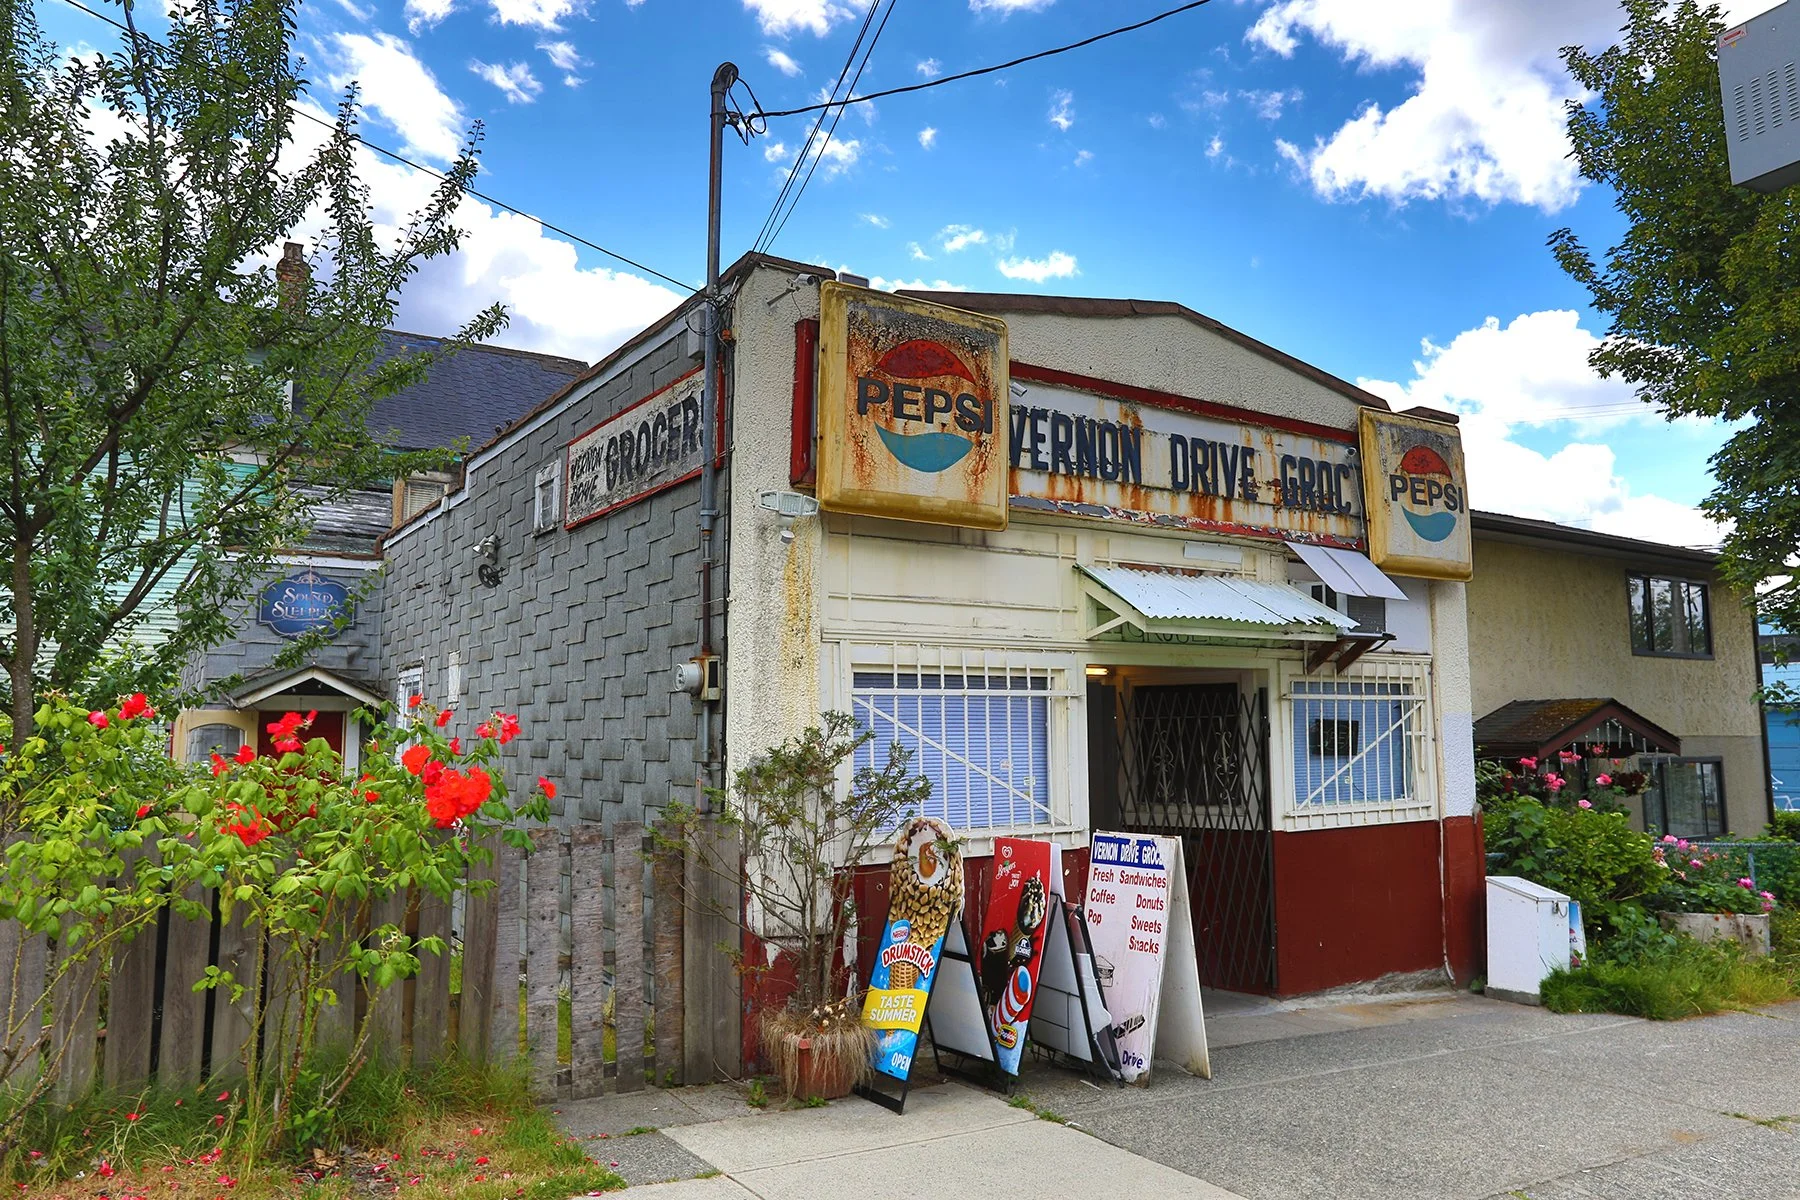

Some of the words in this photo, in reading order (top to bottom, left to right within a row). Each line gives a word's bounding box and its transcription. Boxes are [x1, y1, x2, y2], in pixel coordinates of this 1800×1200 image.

[857, 376, 993, 434] PEPSI
[605, 389, 704, 491] GROCER
[1009, 404, 1142, 484] VERNON
[1170, 432, 1257, 501] DRIVE
[1390, 474, 1465, 514] PEPSI
[1094, 841, 1118, 861] VERNON
[1120, 843, 1139, 864] DRIVE
[1093, 867, 1115, 883] Fresh
[1119, 870, 1167, 889] Sandwiches
[1090, 888, 1116, 905] Coffee
[1136, 893, 1164, 911] Donuts
[1087, 908, 1102, 927] Pop
[1131, 915, 1162, 934] Sweets
[1129, 935, 1159, 954] Snacks
[882, 942, 935, 977] DRUMSTICK
[880, 994, 915, 1008] TASTE
[870, 1008, 917, 1023] SUMMER
[892, 1052, 912, 1072] OPEN
[1122, 1050, 1143, 1069] Drive
